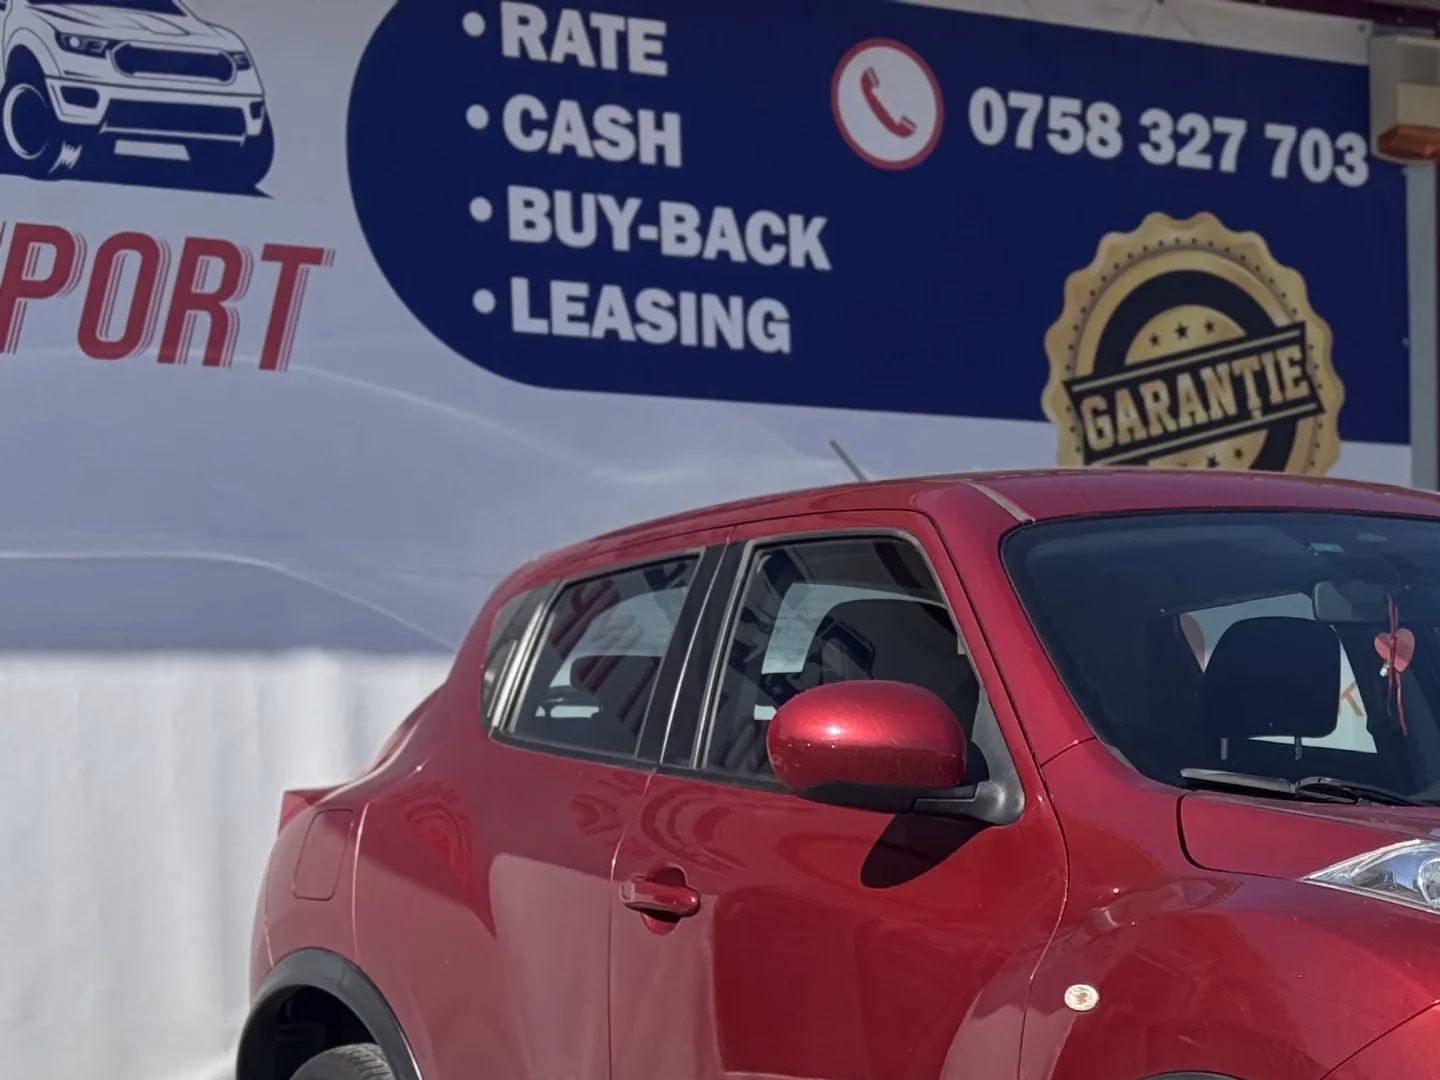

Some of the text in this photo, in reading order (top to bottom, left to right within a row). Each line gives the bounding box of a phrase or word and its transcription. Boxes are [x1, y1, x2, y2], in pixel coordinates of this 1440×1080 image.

[500, 1, 668, 77] RATE
[503, 94, 682, 168] CASH
[968, 87, 1369, 187] 0758 327 703
[507, 185, 832, 271] BUY-BACK
[0, 221, 336, 372] PORT
[510, 276, 791, 354] LEASING
